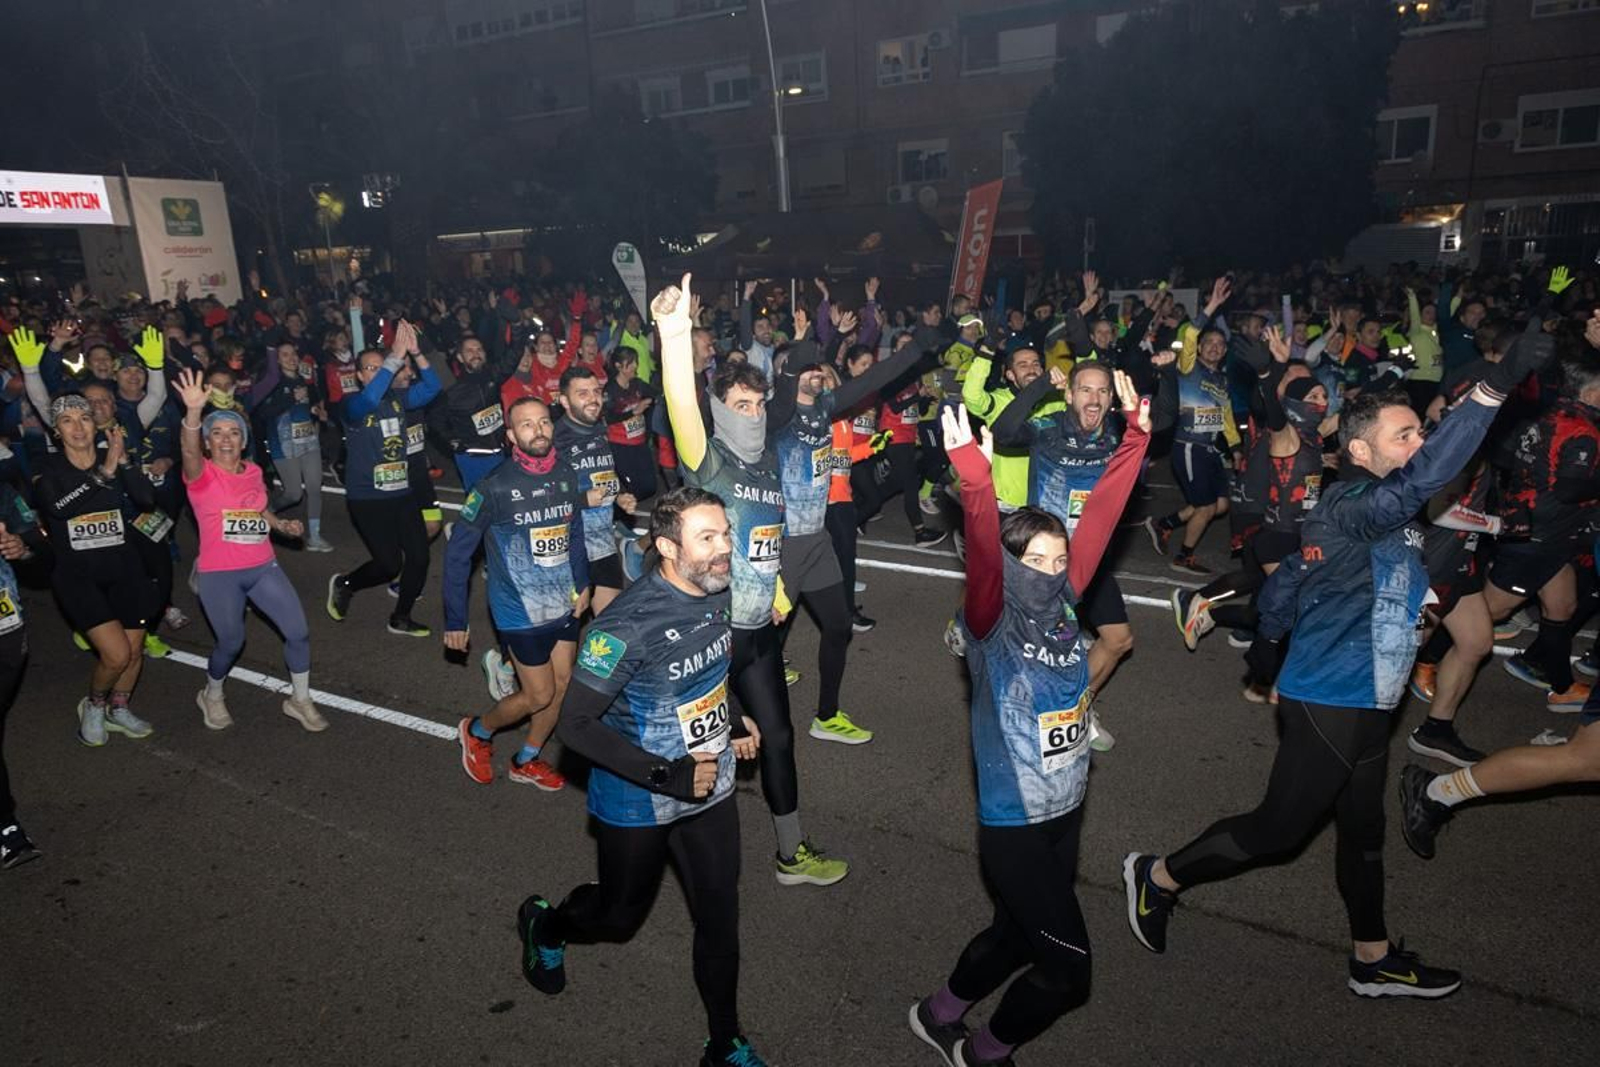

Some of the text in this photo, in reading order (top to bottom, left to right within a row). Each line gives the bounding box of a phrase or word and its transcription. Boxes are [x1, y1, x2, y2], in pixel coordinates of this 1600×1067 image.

[20, 191, 51, 209] SAN
[51, 192, 101, 209] ANTON
[734, 483, 760, 502] SAN
[227, 519, 267, 532] 7620
[513, 510, 542, 525] SAN
[74, 520, 119, 537] 9008
[668, 651, 704, 681] SAN
